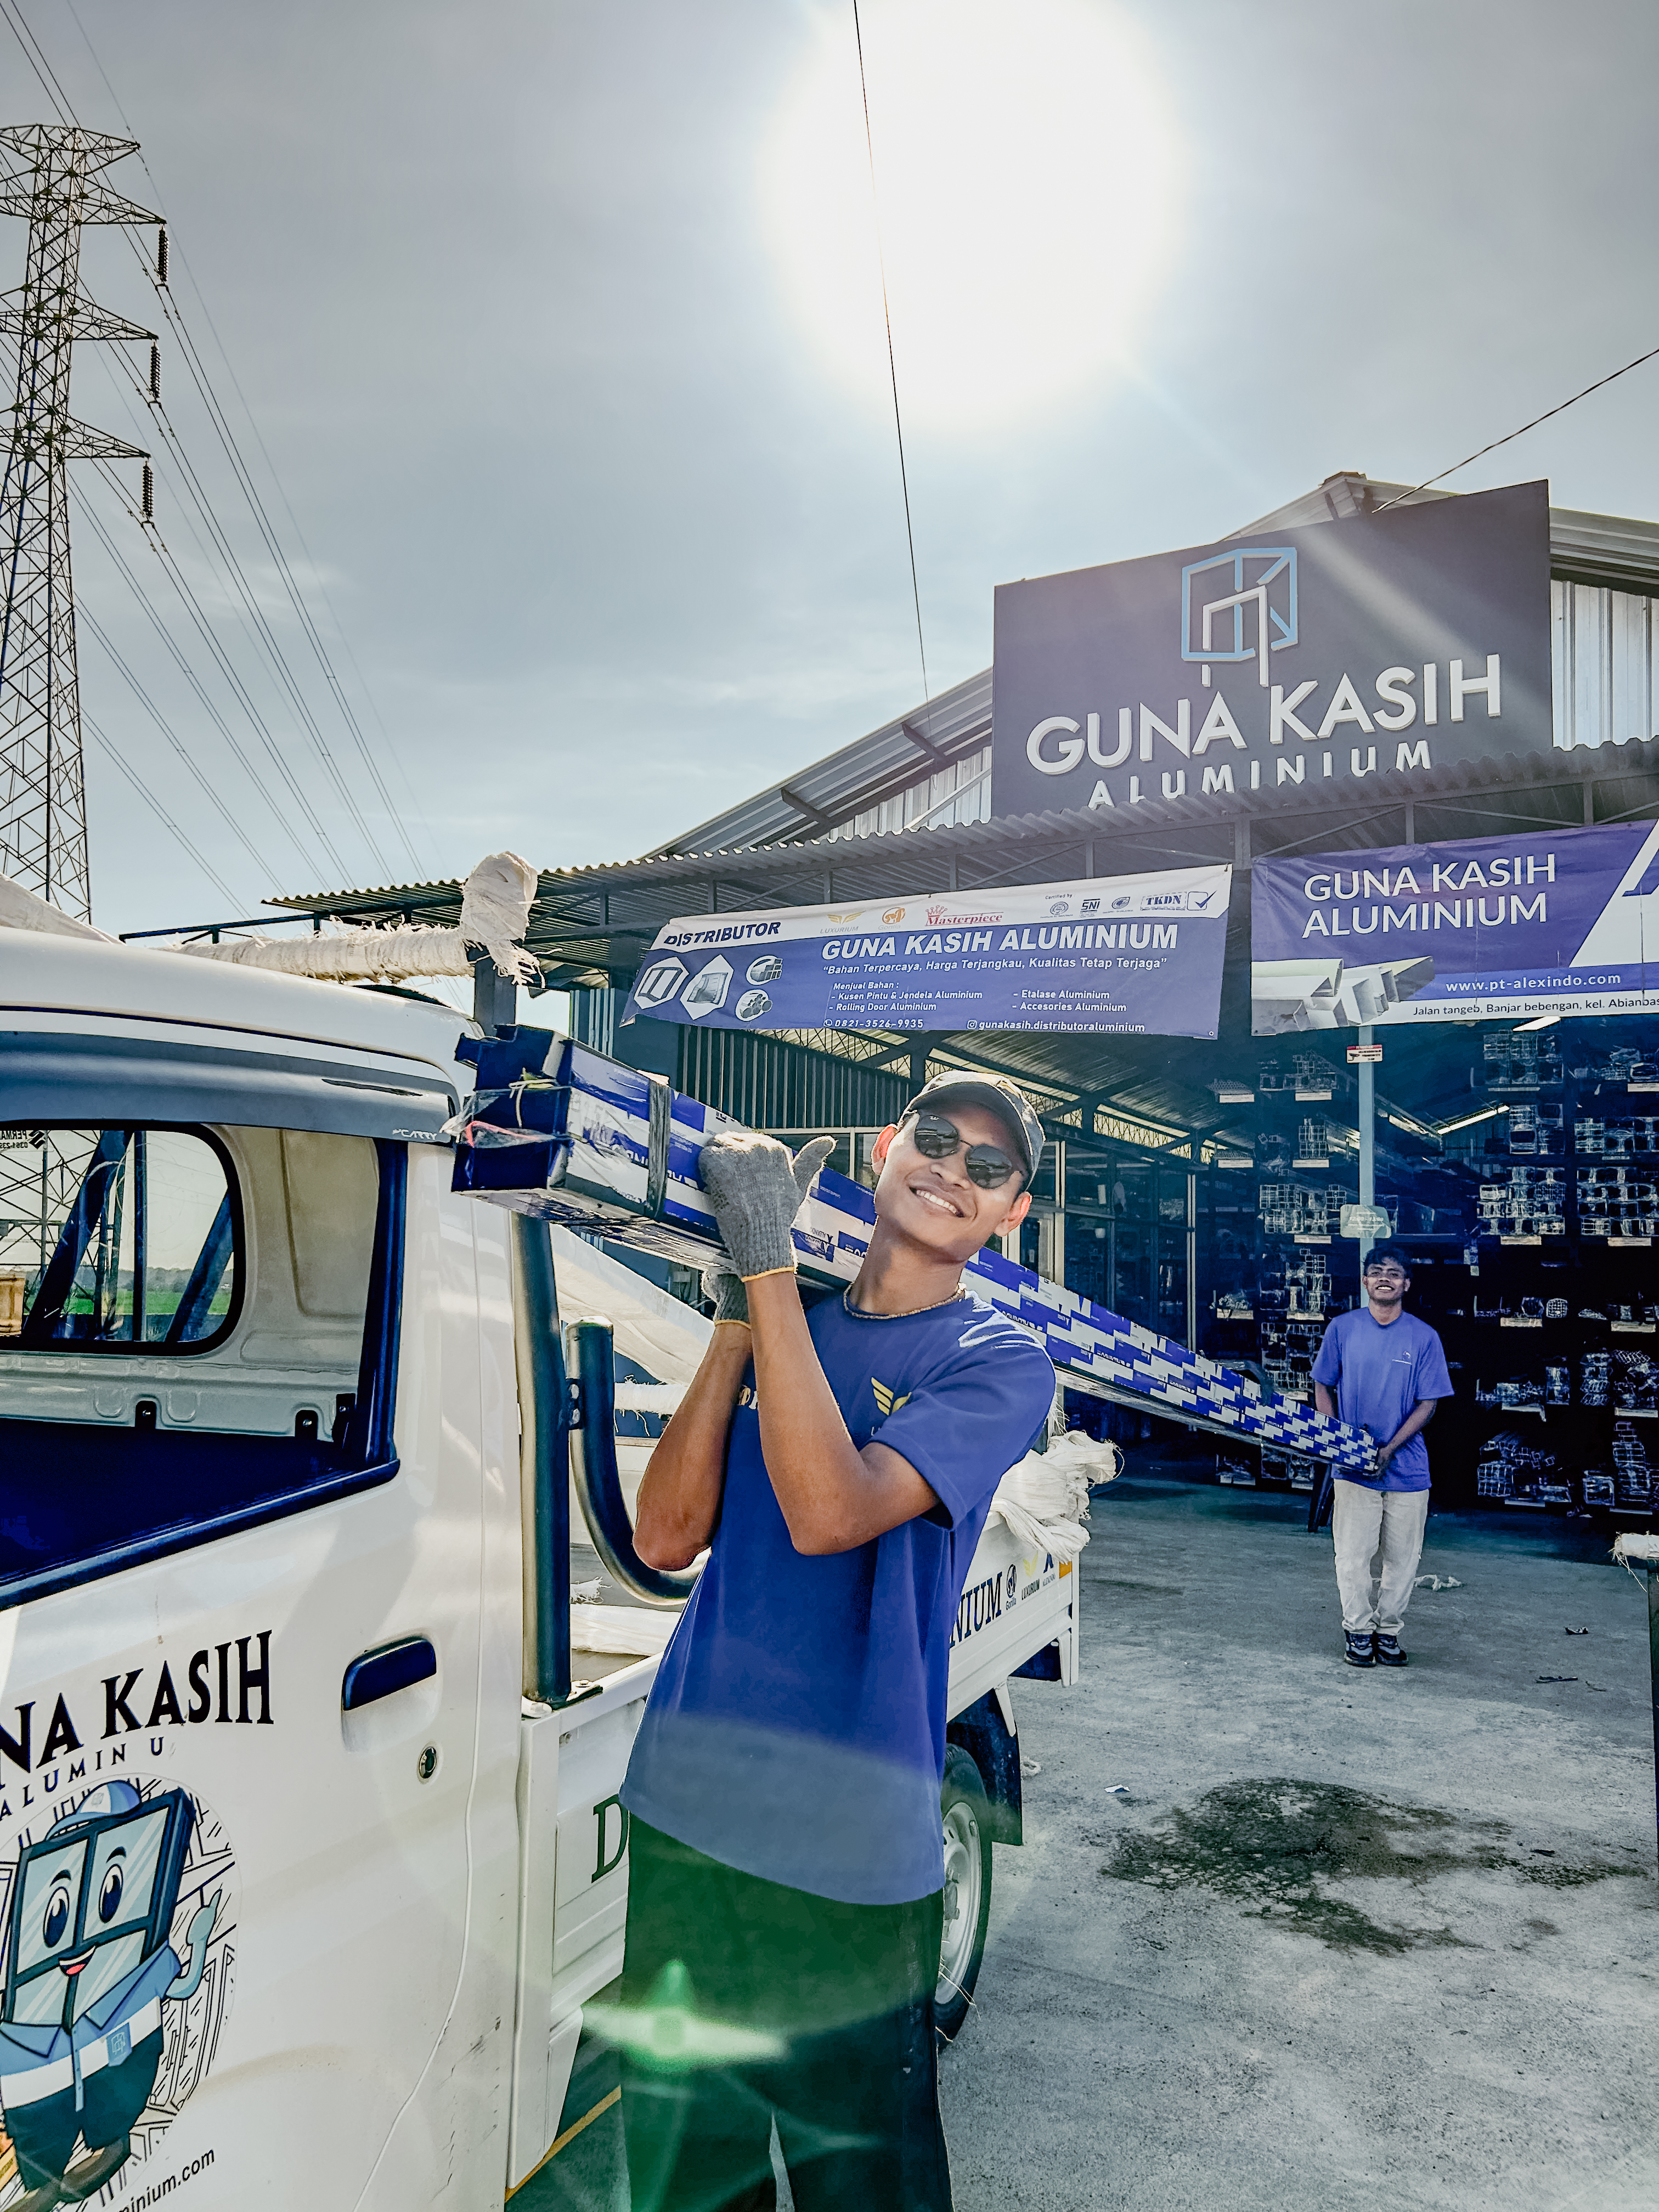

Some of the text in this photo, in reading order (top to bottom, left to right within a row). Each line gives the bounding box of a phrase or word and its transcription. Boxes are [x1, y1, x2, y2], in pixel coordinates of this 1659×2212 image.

[1026, 653, 1501, 776] GUNA KASIH
[1088, 740, 1431, 811] ALUMINIUM
[1304, 853, 1556, 901] GUNA KASIH
[1081, 901, 1101, 911] SNI
[1146, 895, 1182, 905] TKDN
[925, 913, 1003, 926] Masterpiece
[1302, 893, 1547, 939] ALUMINIUM
[663, 922, 781, 947] DISTRIBUTOR
[822, 924, 1178, 960] GUNA KASIH ALUMINIUM
[863, 962, 922, 974] Terpercaya,
[926, 961, 957, 970] Harga
[961, 958, 1025, 971] Terjangkau,
[1029, 957, 1076, 968] Kualitas
[1080, 957, 1112, 969] Tetap
[833, 982, 866, 991] Menjual
[1446, 975, 1621, 992] www.pt-alexindo.com
[838, 992, 864, 1000] Kusen
[866, 991, 888, 1000] Pintu
[899, 991, 933, 999] Jendela
[934, 990, 983, 999] Aluminium
[1021, 989, 1056, 999] Etalase
[1059, 990, 1110, 1000] Aluminium
[836, 1002, 865, 1013] Rolling
[867, 1002, 888, 1011] Door
[890, 1002, 936, 1011] Aluminium
[1019, 1001, 1073, 1011] Accesories
[1074, 1002, 1127, 1012] Aluminium
[1413, 1006, 1440, 1015] Jalan
[1443, 1005, 1482, 1015] tangeb,
[1487, 1003, 1521, 1013] Banjar
[1525, 1001, 1582, 1012] bebengan,
[1585, 999, 1605, 1008] kel.
[834, 1019, 924, 1028] 0821-3526-9935
[978, 1020, 1146, 1032] gunakasih.distributoraluminium
[401, 1128, 437, 1141] CARRY
[100, 1629, 274, 1740] KASIH
